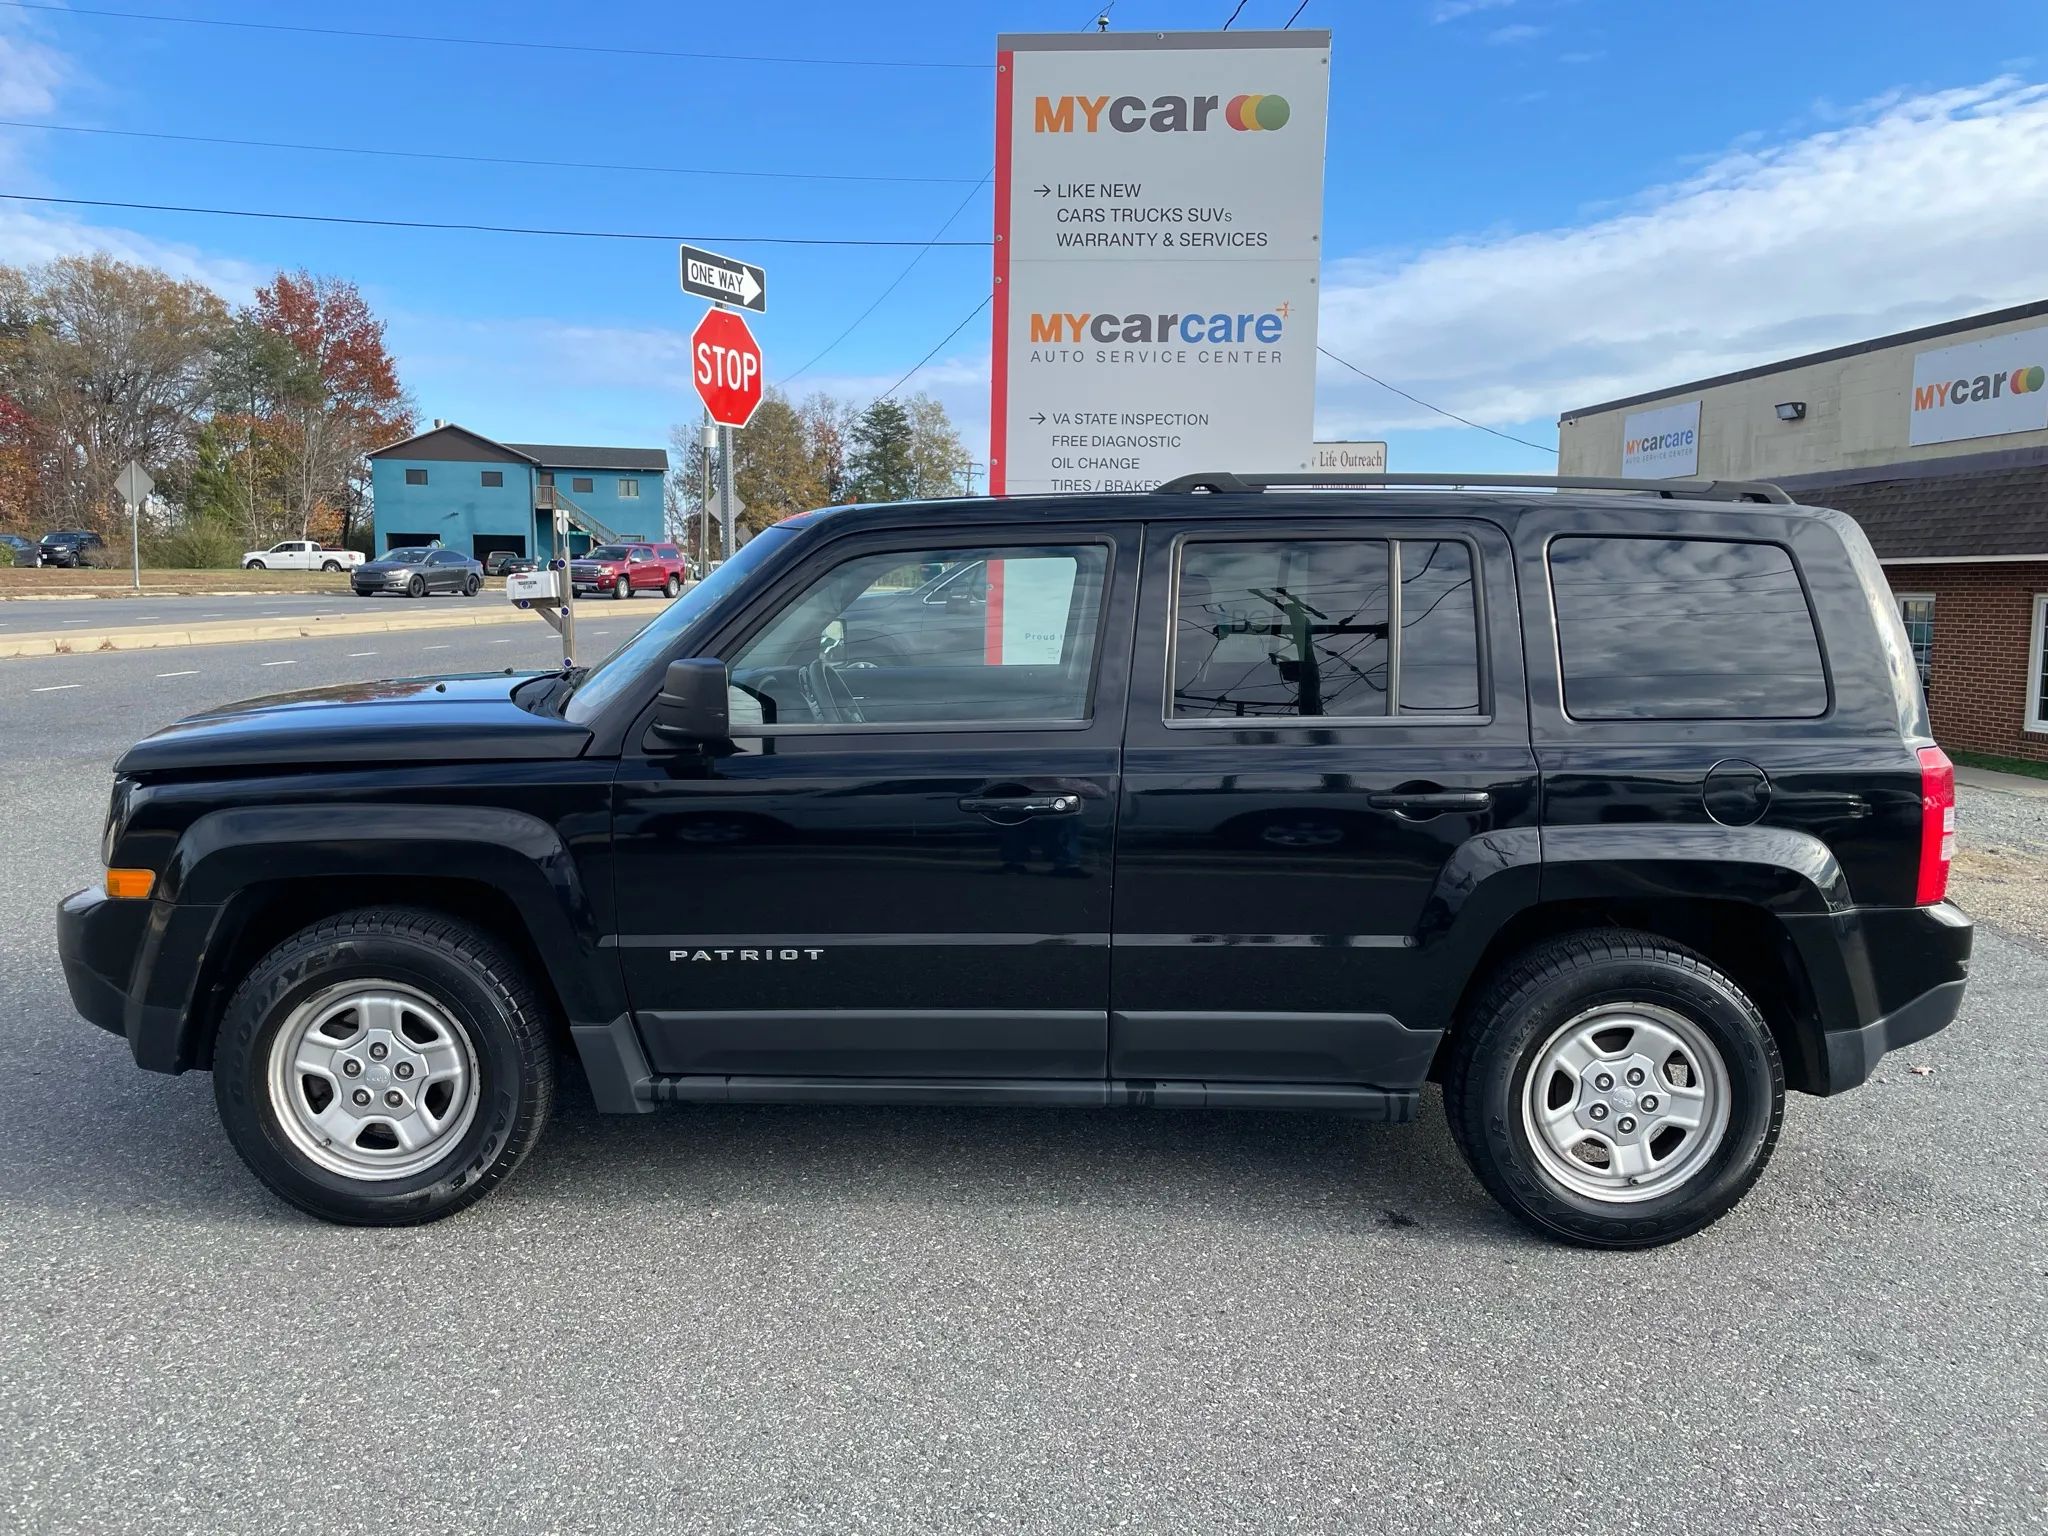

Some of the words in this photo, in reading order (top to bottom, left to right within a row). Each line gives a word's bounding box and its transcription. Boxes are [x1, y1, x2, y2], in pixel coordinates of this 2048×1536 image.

[1034, 95, 1219, 133] MYcar
[1057, 183, 1096, 198] LIKE
[1099, 183, 1142, 198] NEW
[1056, 207, 1106, 222] CARS
[1110, 207, 1183, 222] TRUCKS
[1187, 207, 1233, 222] SUVs
[1056, 232, 1158, 247] WARRANTY
[1162, 232, 1175, 247] &
[1179, 232, 1268, 247] SERVICES
[690, 262, 715, 285] ONE
[718, 269, 744, 293] WAY
[1030, 313, 1283, 344] MYcarcare
[1030, 350, 1085, 363] AUTO
[1096, 350, 1186, 363] SERVICE
[1198, 350, 1282, 364] CENTER
[697, 342, 758, 392] STOP
[1914, 371, 2008, 412] MYcar
[1052, 413, 1071, 425] VA
[1074, 413, 1118, 425] STATE
[1121, 413, 1209, 426] INSPECTION
[1052, 435, 1088, 447] FREE
[1092, 435, 1181, 448] DIAGNOSTIC
[1626, 429, 1694, 456] MYcarcare
[1051, 457, 1074, 469] OIL
[1078, 457, 1141, 469] CHANGE
[1319, 450, 1337, 467] Life
[1340, 450, 1383, 467] Outreach
[1051, 479, 1092, 491] TIRES
[1095, 479, 1101, 491] /
[1104, 480, 1162, 492] BRAKES
[1024, 632, 1056, 641] Proud
[669, 949, 825, 962] PATRIOT
